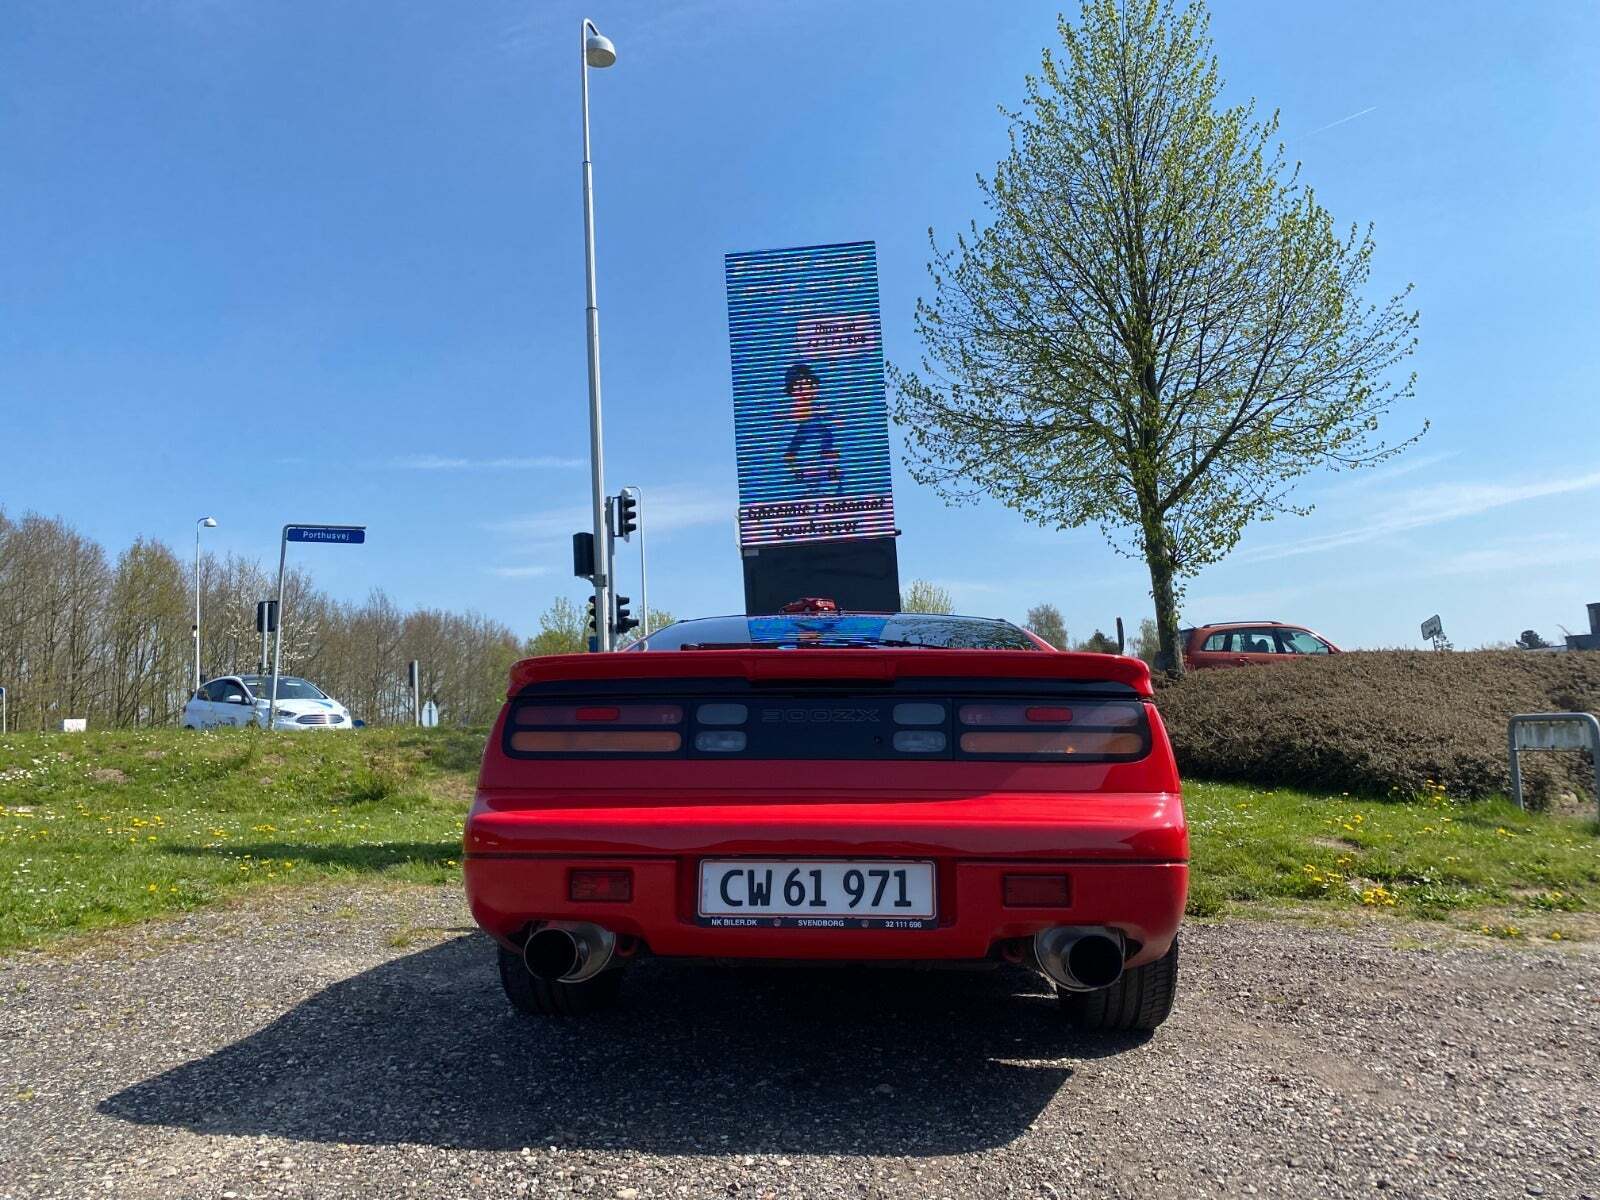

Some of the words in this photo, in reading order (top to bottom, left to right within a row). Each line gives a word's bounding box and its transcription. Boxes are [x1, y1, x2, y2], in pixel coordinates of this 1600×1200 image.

[303, 530, 349, 540] Porthusvej
[761, 708, 881, 722] 300ZX
[719, 869, 773, 907] CW
[783, 868, 827, 907] 61
[842, 869, 912, 908] 971
